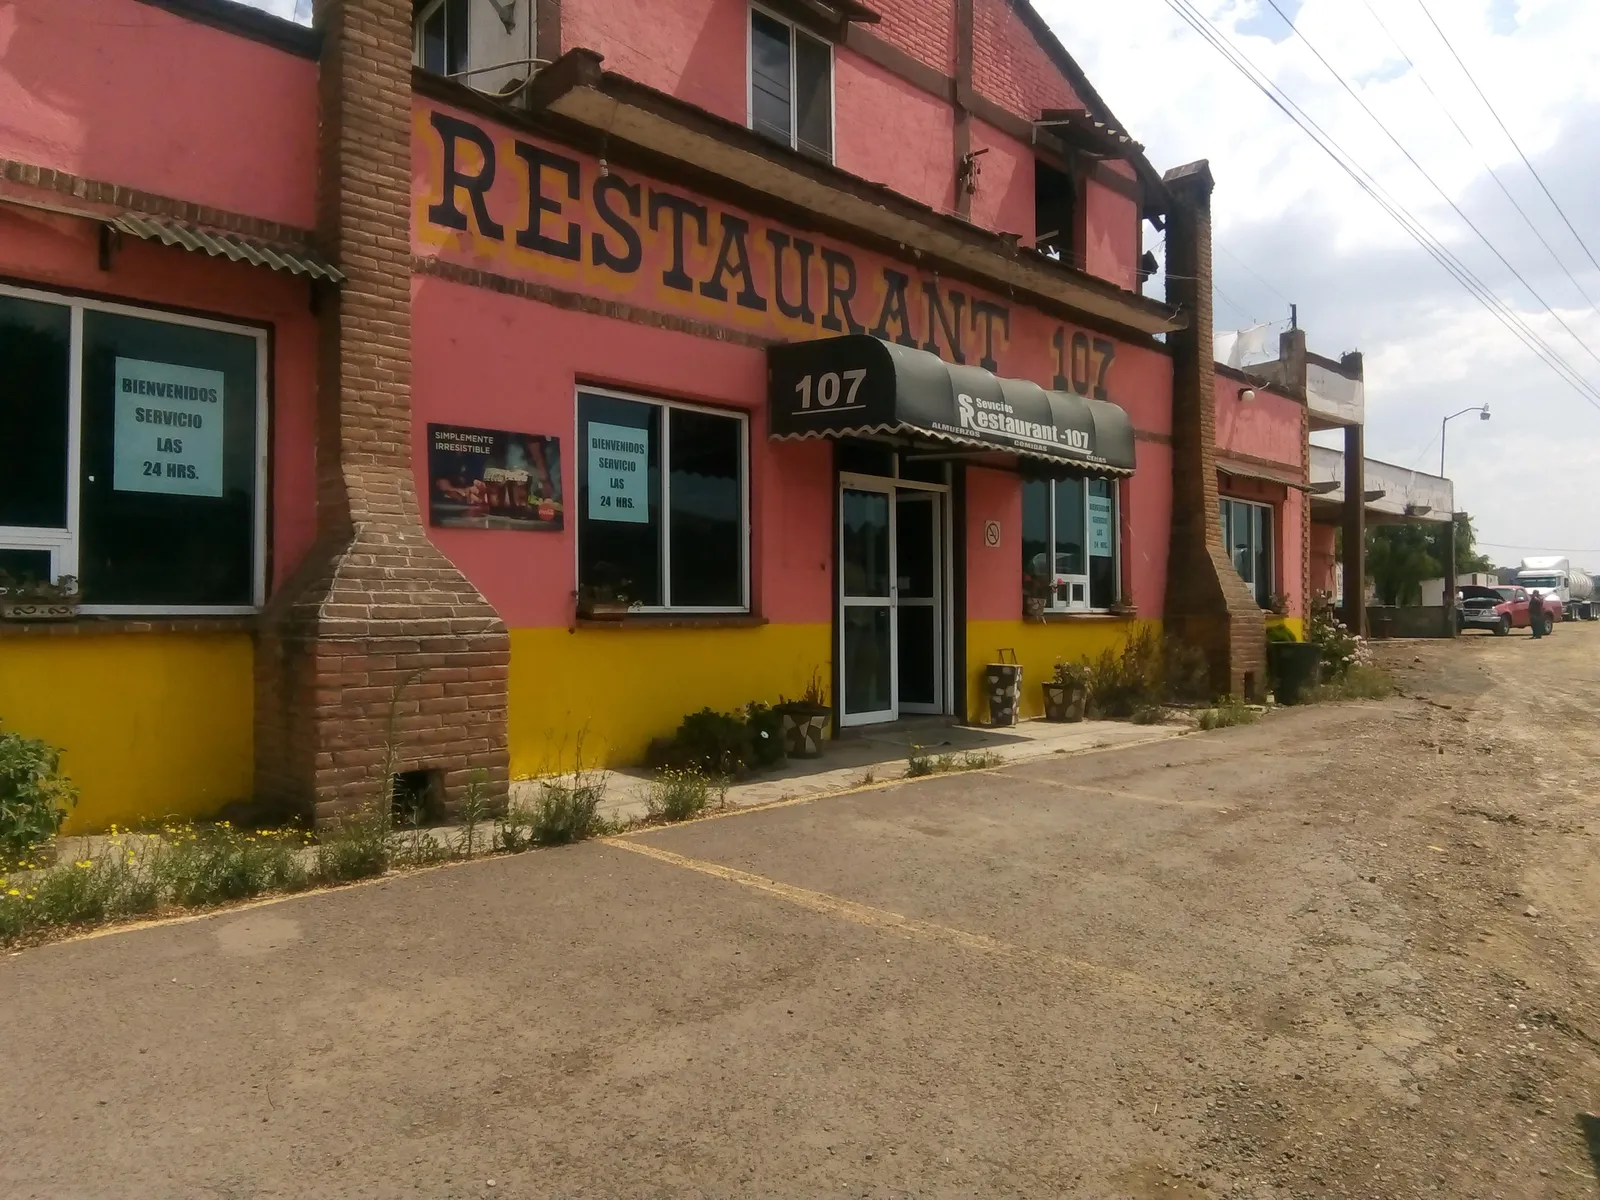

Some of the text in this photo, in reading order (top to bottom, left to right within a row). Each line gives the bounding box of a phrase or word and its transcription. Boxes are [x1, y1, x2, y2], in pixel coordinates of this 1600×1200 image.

[429, 111, 1115, 400] RESTAURANT 107
[122, 377, 218, 404] BIENVENIDOS
[795, 369, 867, 409] 107
[135, 407, 203, 429] SERVICIO
[435, 431, 494, 445] SIMPLEMENTE
[931, 421, 981, 438] ALMUERZOS
[156, 437, 183, 454] LAS
[435, 442, 491, 455] IRRESISTIBLE
[591, 437, 645, 455] BIENVENIDOS
[1014, 440, 1048, 452] COMIDAS
[143, 460, 199, 480] 24 HRS.
[598, 457, 636, 472] SERVICIO
[609, 477, 625, 490] LAS
[600, 496, 636, 509] 24 HRS.
